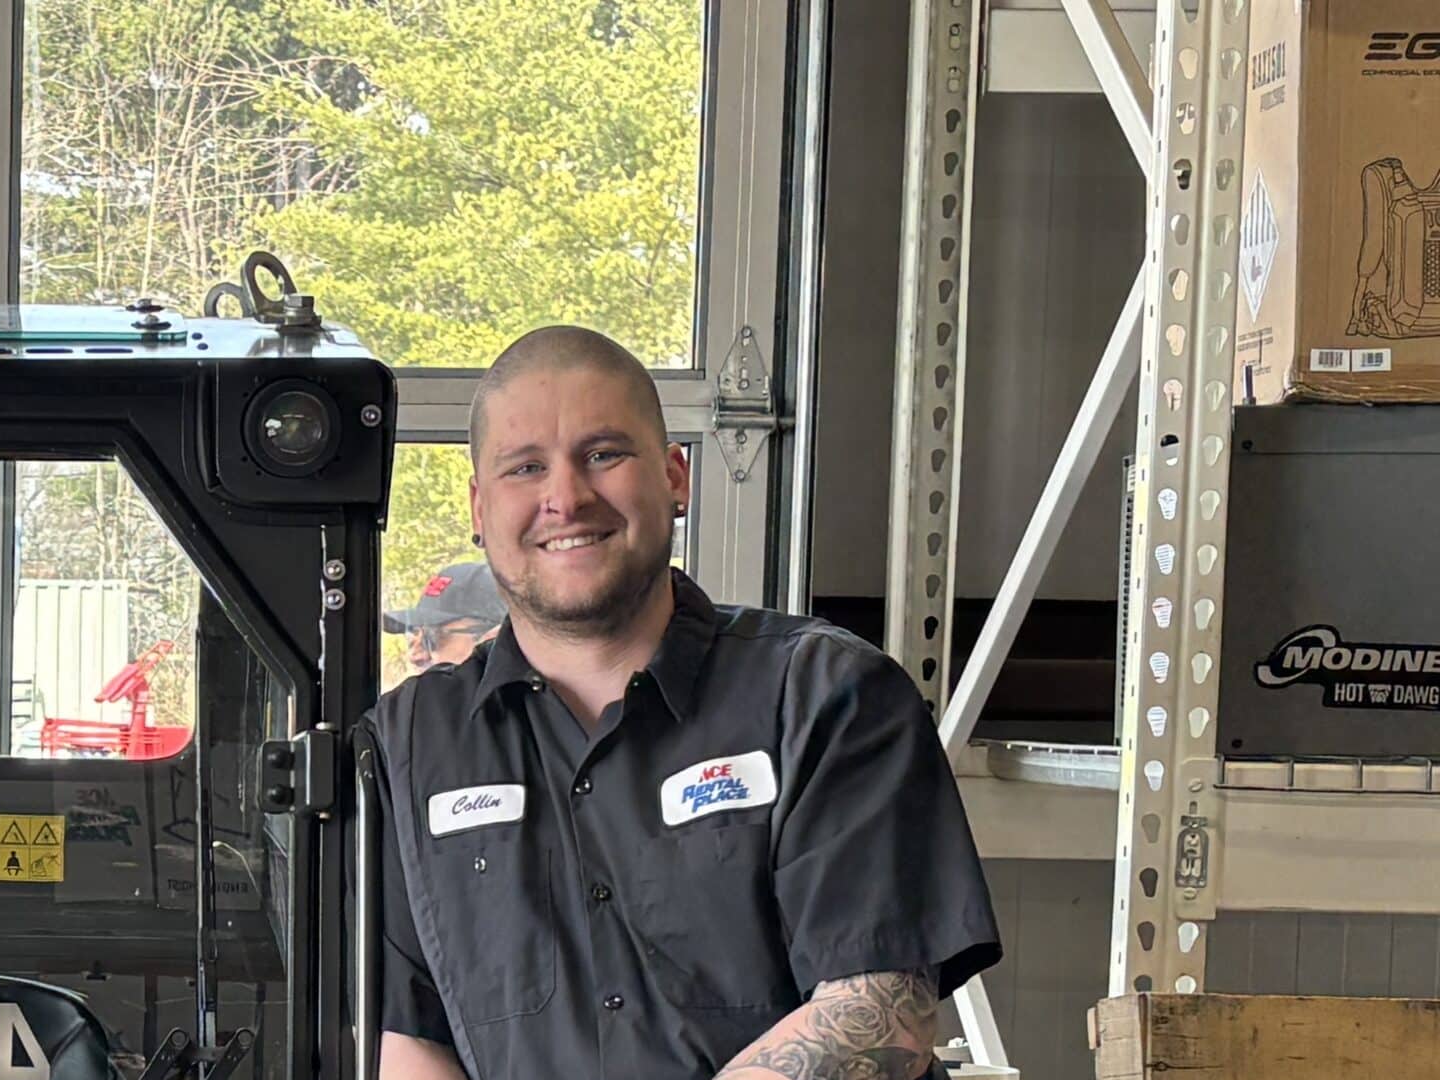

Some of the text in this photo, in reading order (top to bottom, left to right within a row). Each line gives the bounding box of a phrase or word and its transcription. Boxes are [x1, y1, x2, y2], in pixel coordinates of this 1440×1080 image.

[1335, 683, 1439, 705] HOT DAWG
[699, 764, 733, 783] ACE
[681, 778, 745, 804] RENTAL
[691, 788, 751, 814] PLACE
[451, 795, 503, 817] Collin
